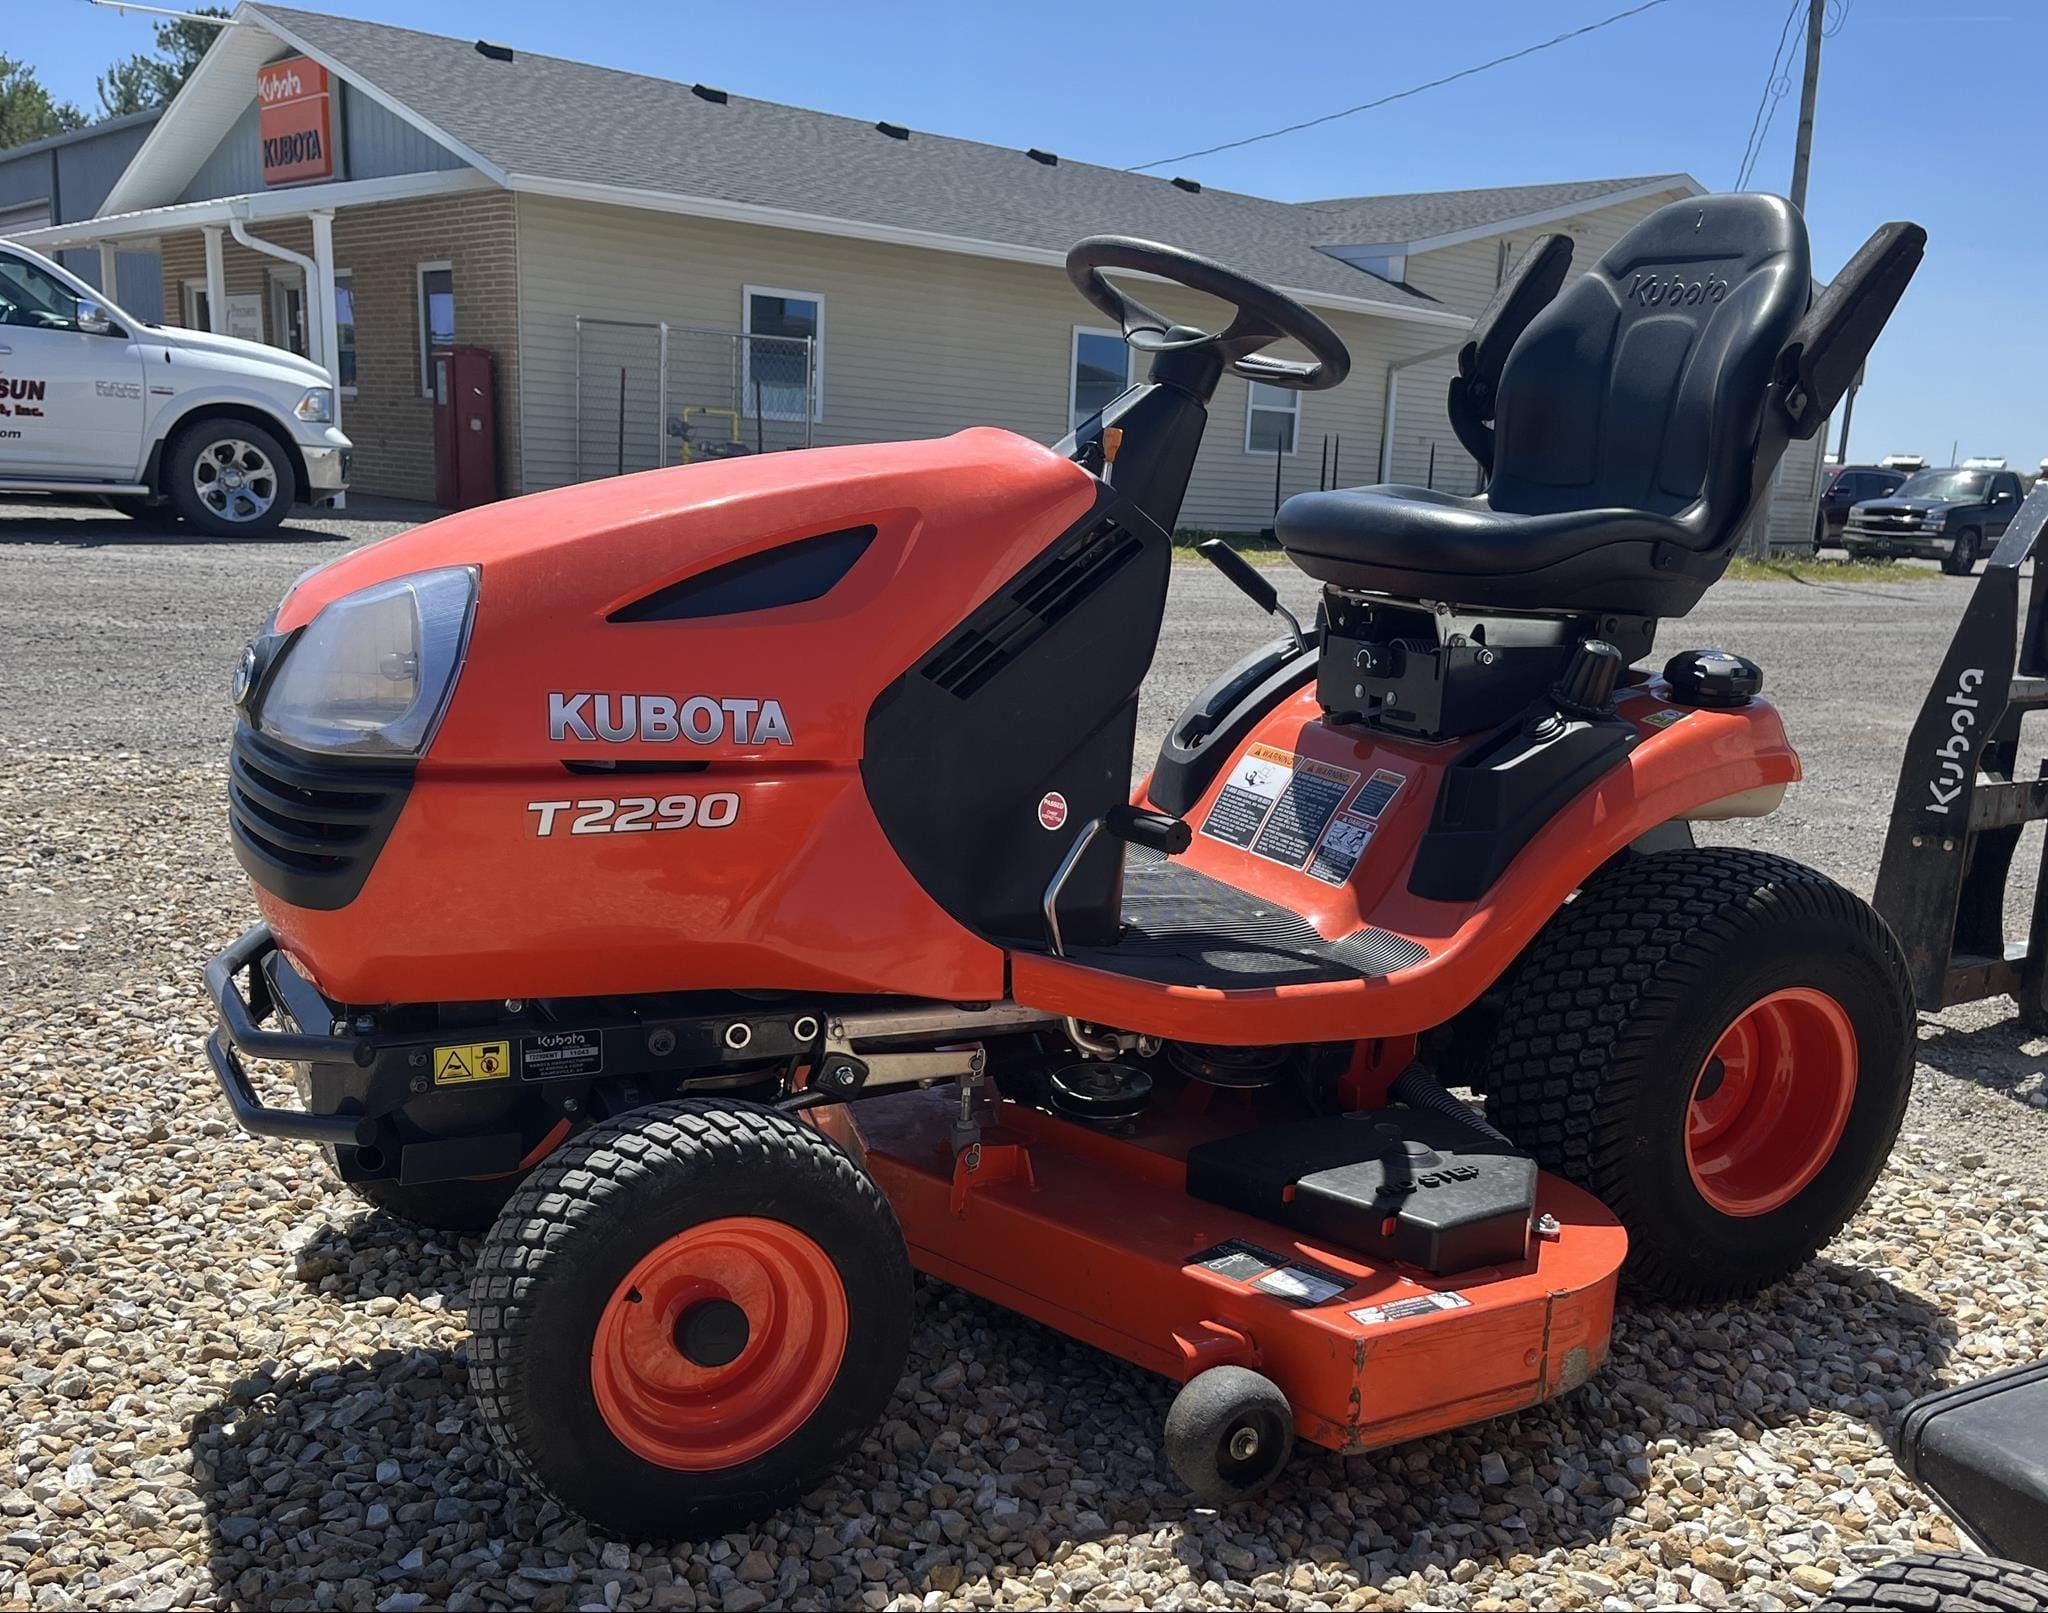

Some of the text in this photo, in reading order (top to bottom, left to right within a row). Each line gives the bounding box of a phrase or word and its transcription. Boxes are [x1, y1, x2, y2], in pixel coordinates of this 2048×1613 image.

[258, 70, 302, 102] Kubota
[264, 130, 322, 168] KUBOTA
[1628, 273, 1728, 307] Kubota
[15, 404, 44, 417] Inc.
[549, 692, 793, 746] KUBOTA
[1262, 749, 1293, 765] WARNING
[1926, 668, 1985, 814] Kubota
[526, 791, 741, 837] T2290
[538, 1033, 585, 1047] Kubota
